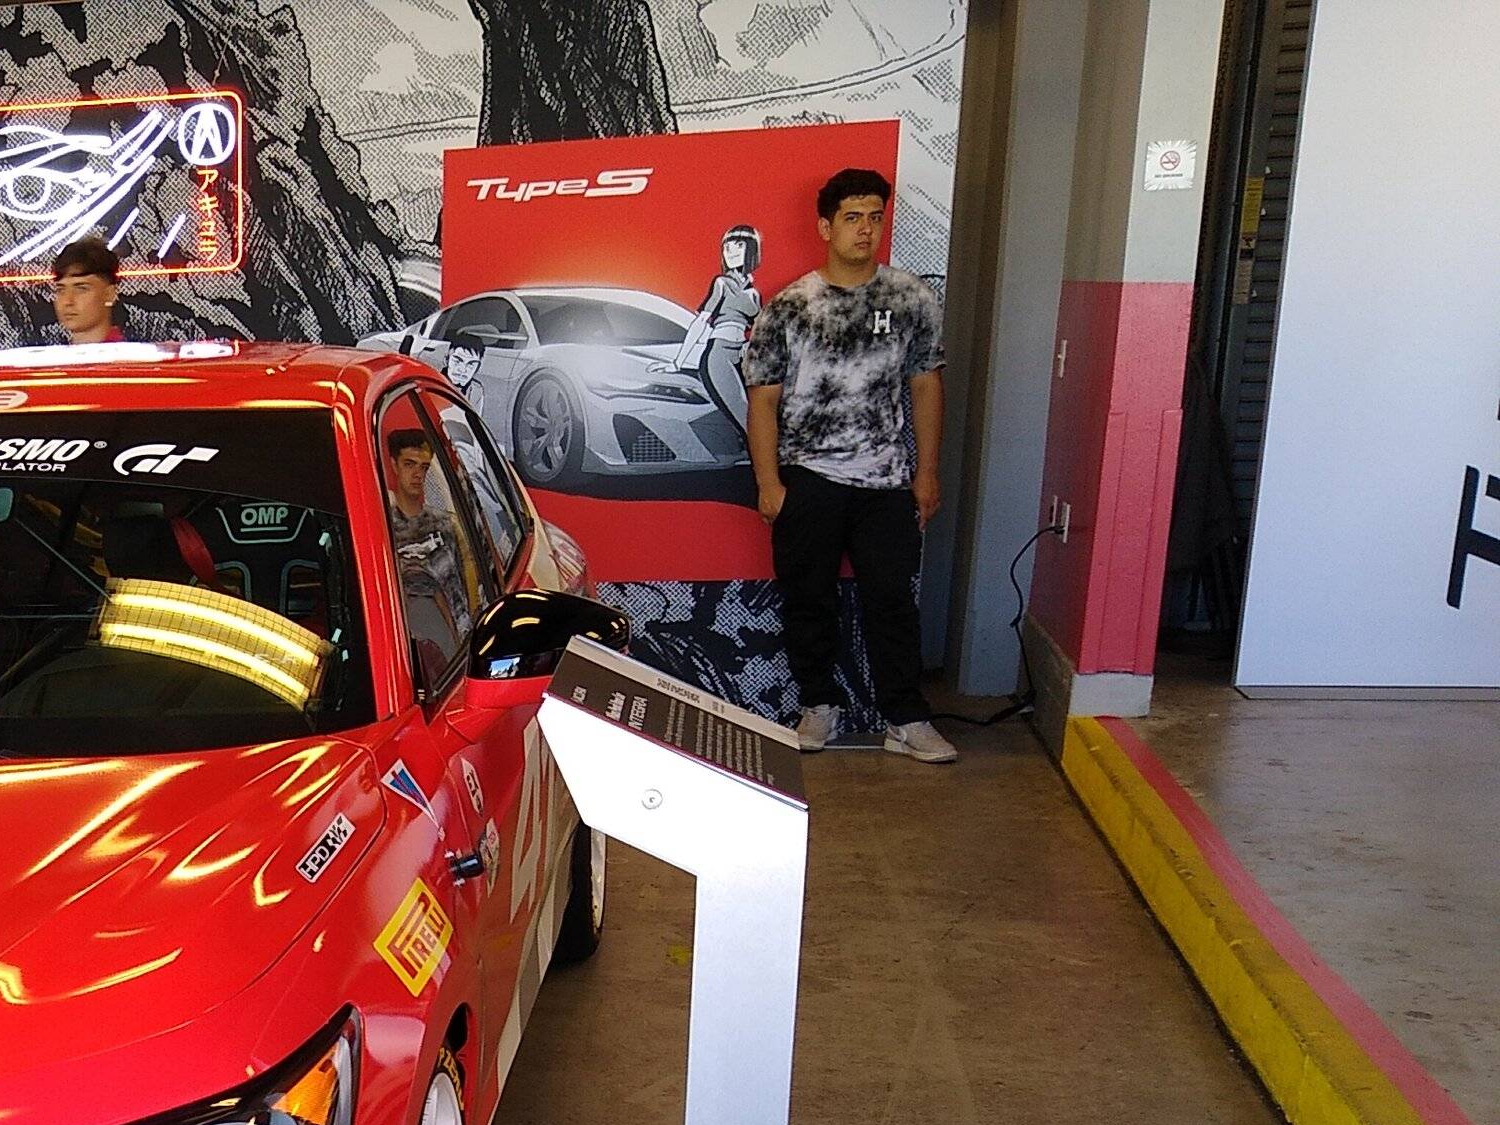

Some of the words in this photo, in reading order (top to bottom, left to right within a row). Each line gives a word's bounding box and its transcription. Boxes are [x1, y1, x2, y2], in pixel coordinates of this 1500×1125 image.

[872, 310, 891, 334] H
[240, 506, 290, 526] OMP
[300, 845, 329, 878] HPD
[386, 891, 446, 980] PIRELLI
